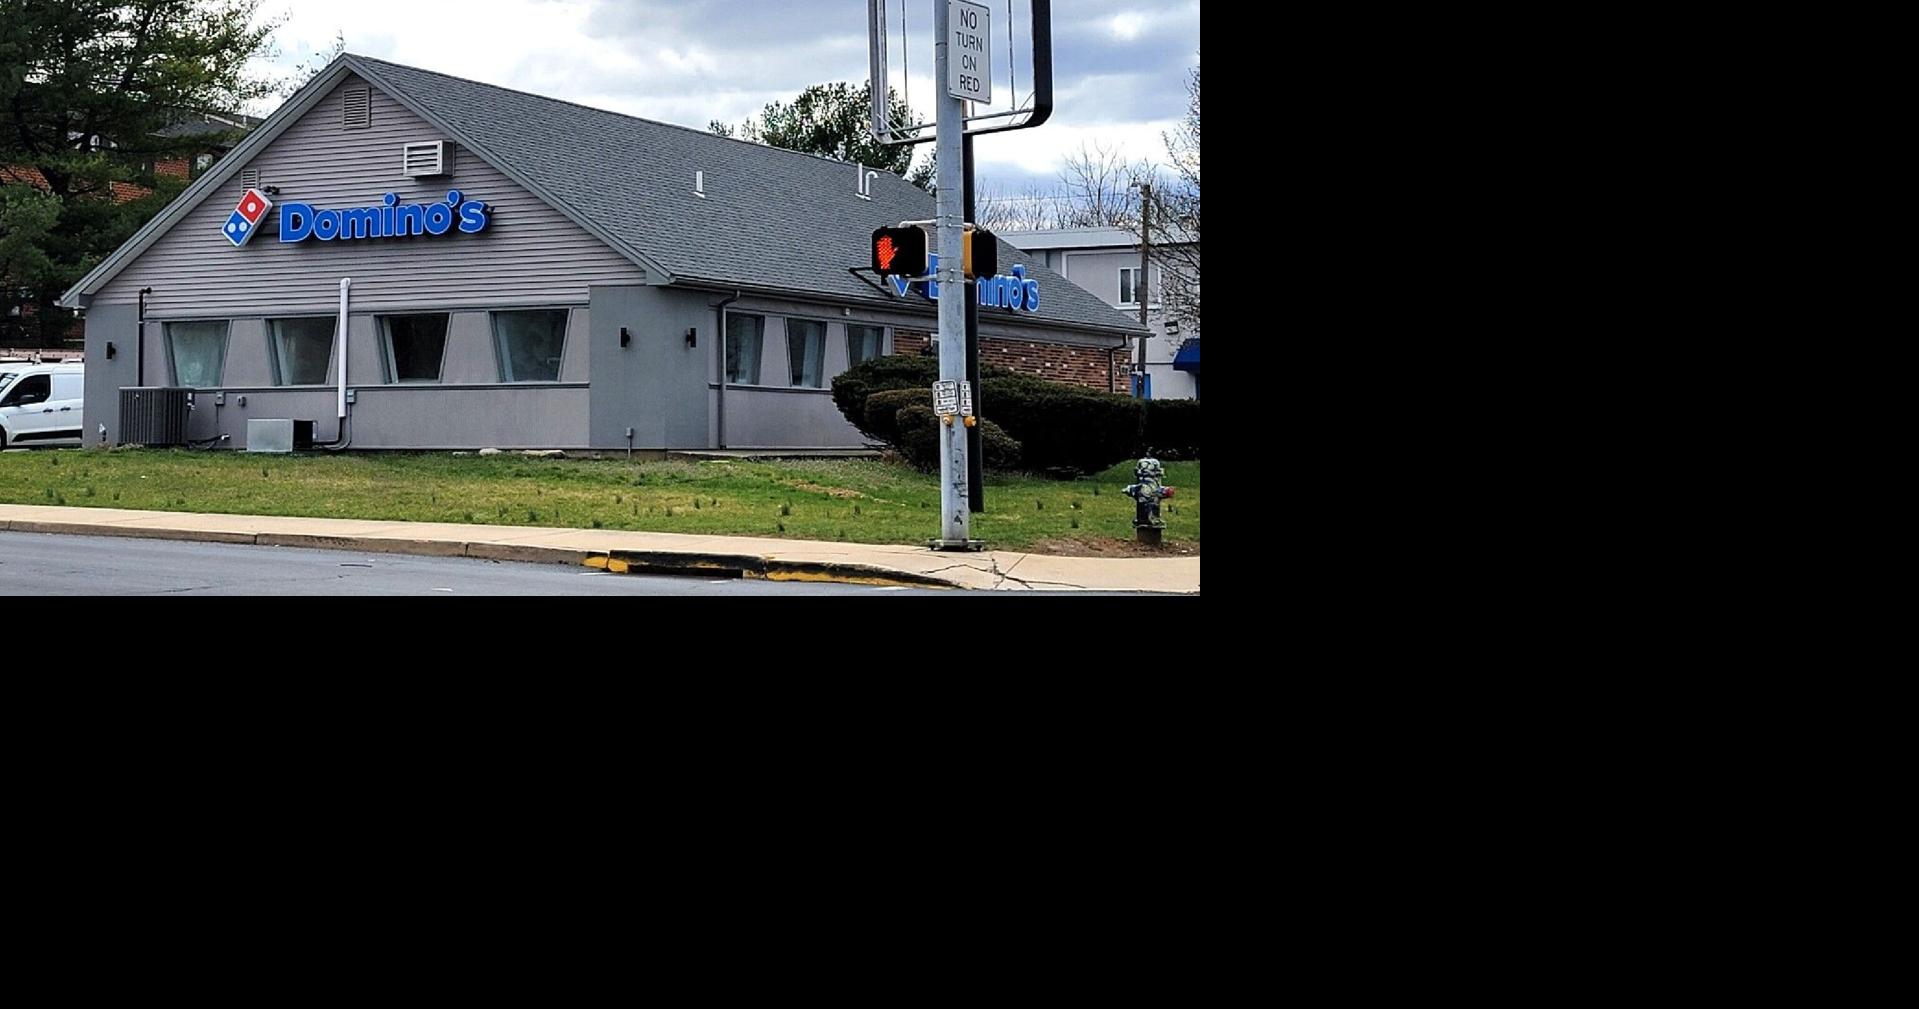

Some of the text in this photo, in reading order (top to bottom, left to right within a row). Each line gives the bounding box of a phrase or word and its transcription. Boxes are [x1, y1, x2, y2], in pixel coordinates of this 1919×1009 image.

[960, 8, 977, 30] NO
[955, 31, 983, 53] TURN
[962, 54, 977, 72] ON
[960, 74, 980, 92] RED
[279, 188, 488, 243] Domino's
